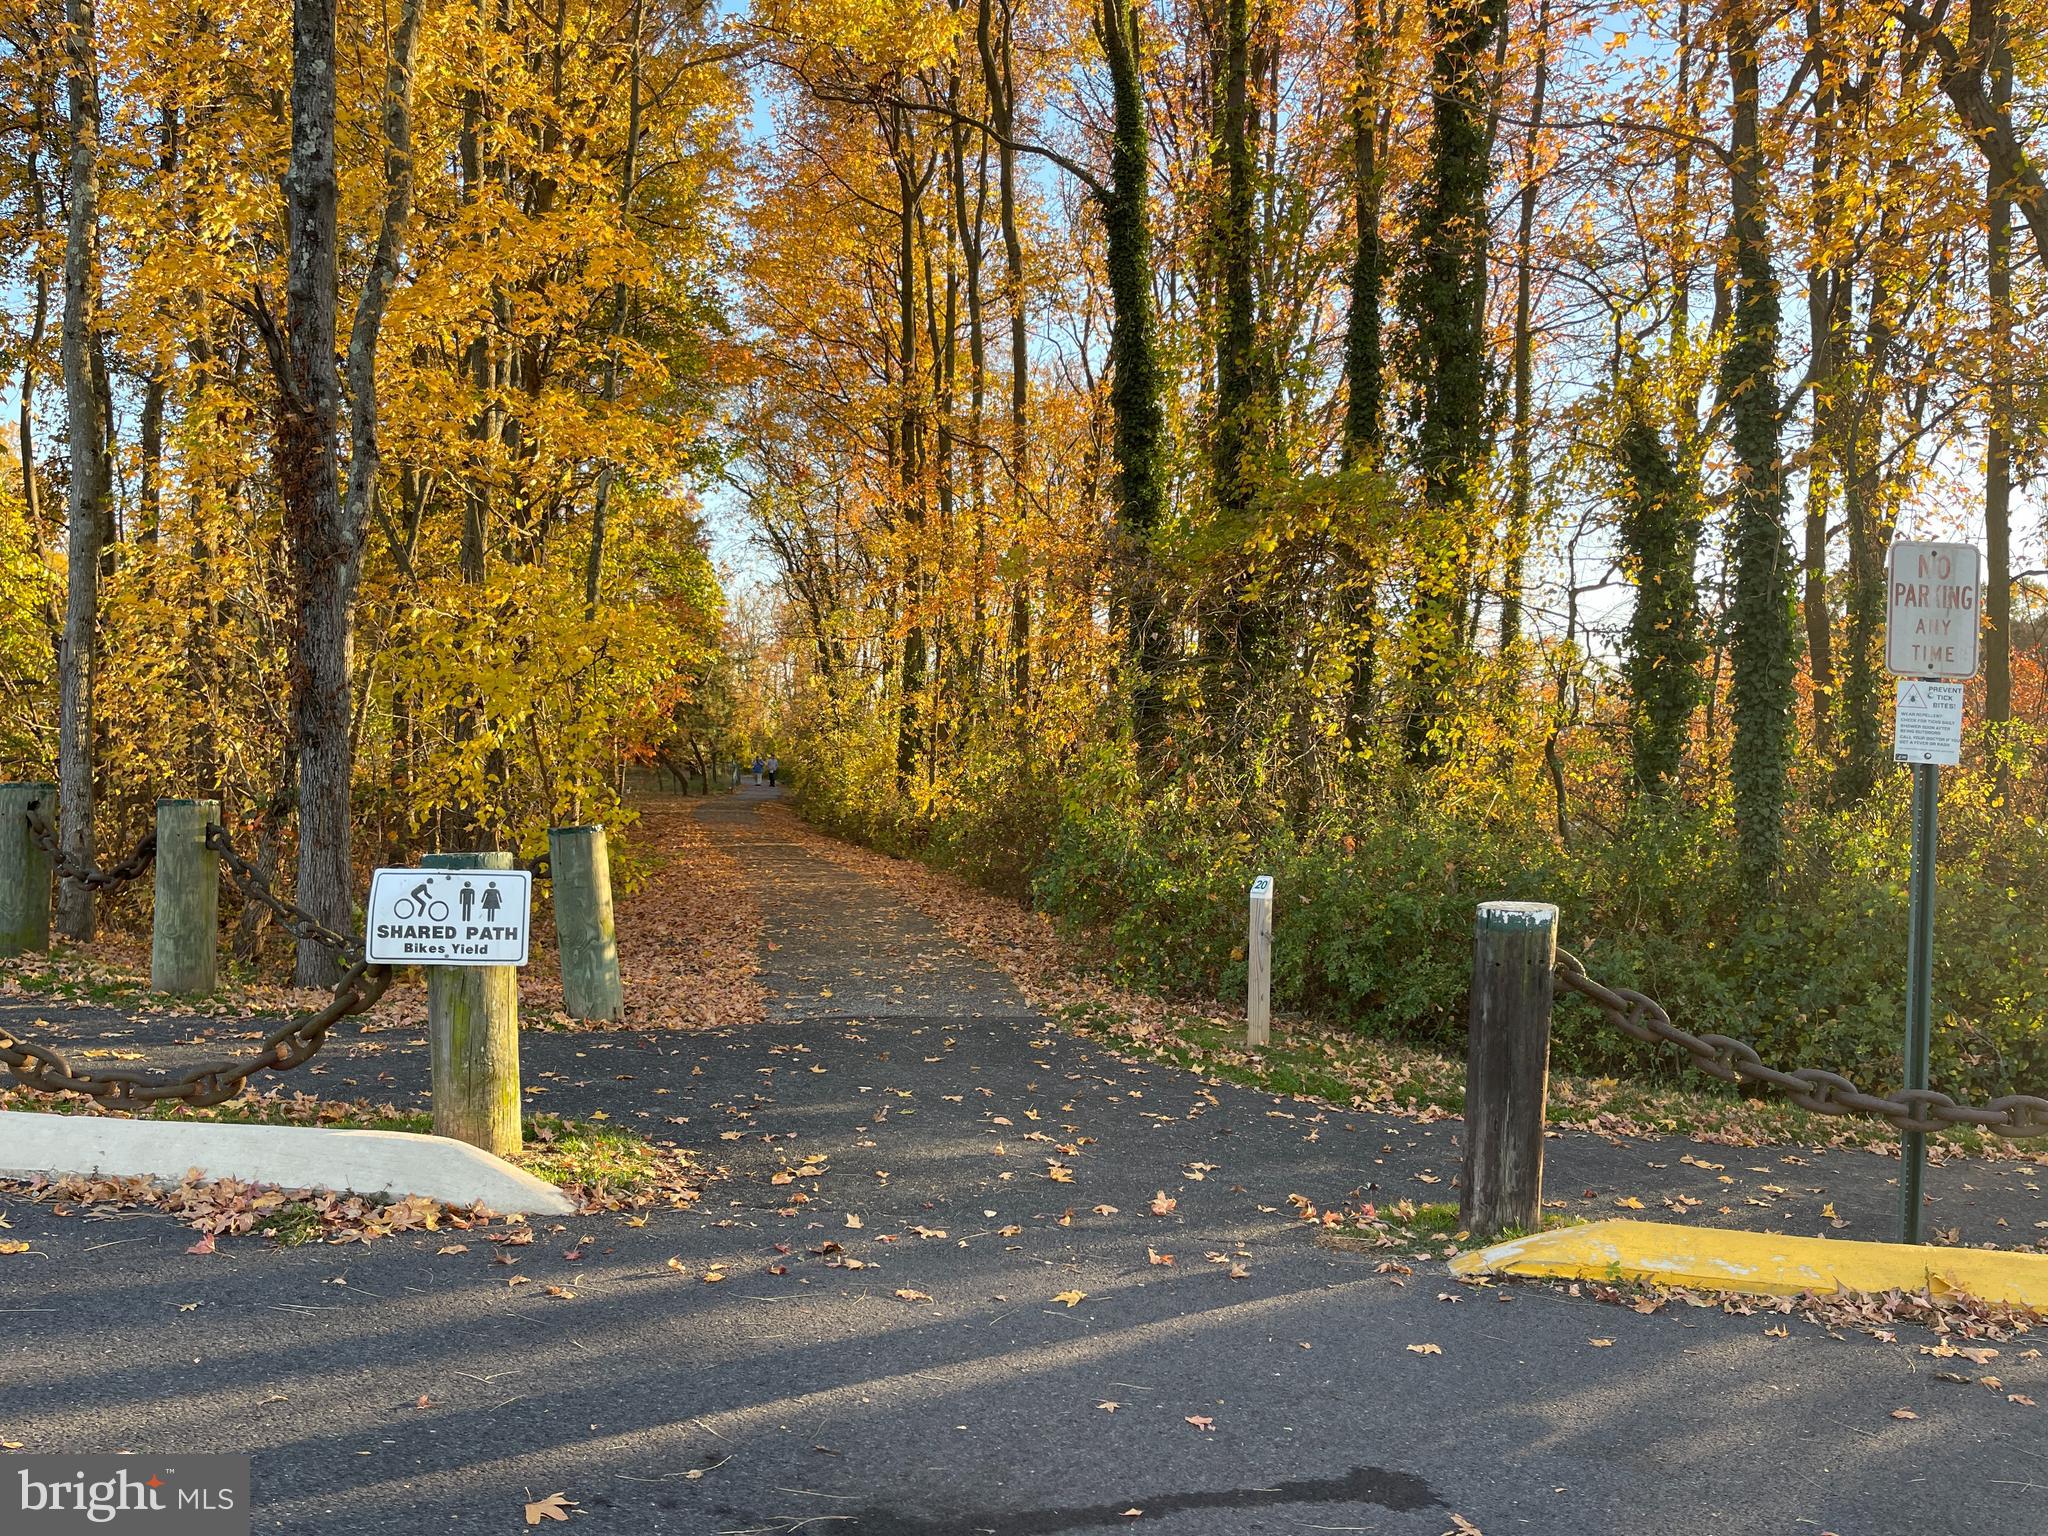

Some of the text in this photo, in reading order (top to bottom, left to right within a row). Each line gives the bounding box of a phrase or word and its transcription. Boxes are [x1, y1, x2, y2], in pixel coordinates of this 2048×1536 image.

[1918, 554, 1951, 580] NO
[1916, 618, 1951, 635] ANY
[1912, 644, 1954, 663] TIME
[1928, 686, 1962, 694] PREVENT
[1254, 880, 1268, 890] 20
[377, 924, 518, 940] SHARED PATH
[404, 943, 488, 955] Bikes Yield
